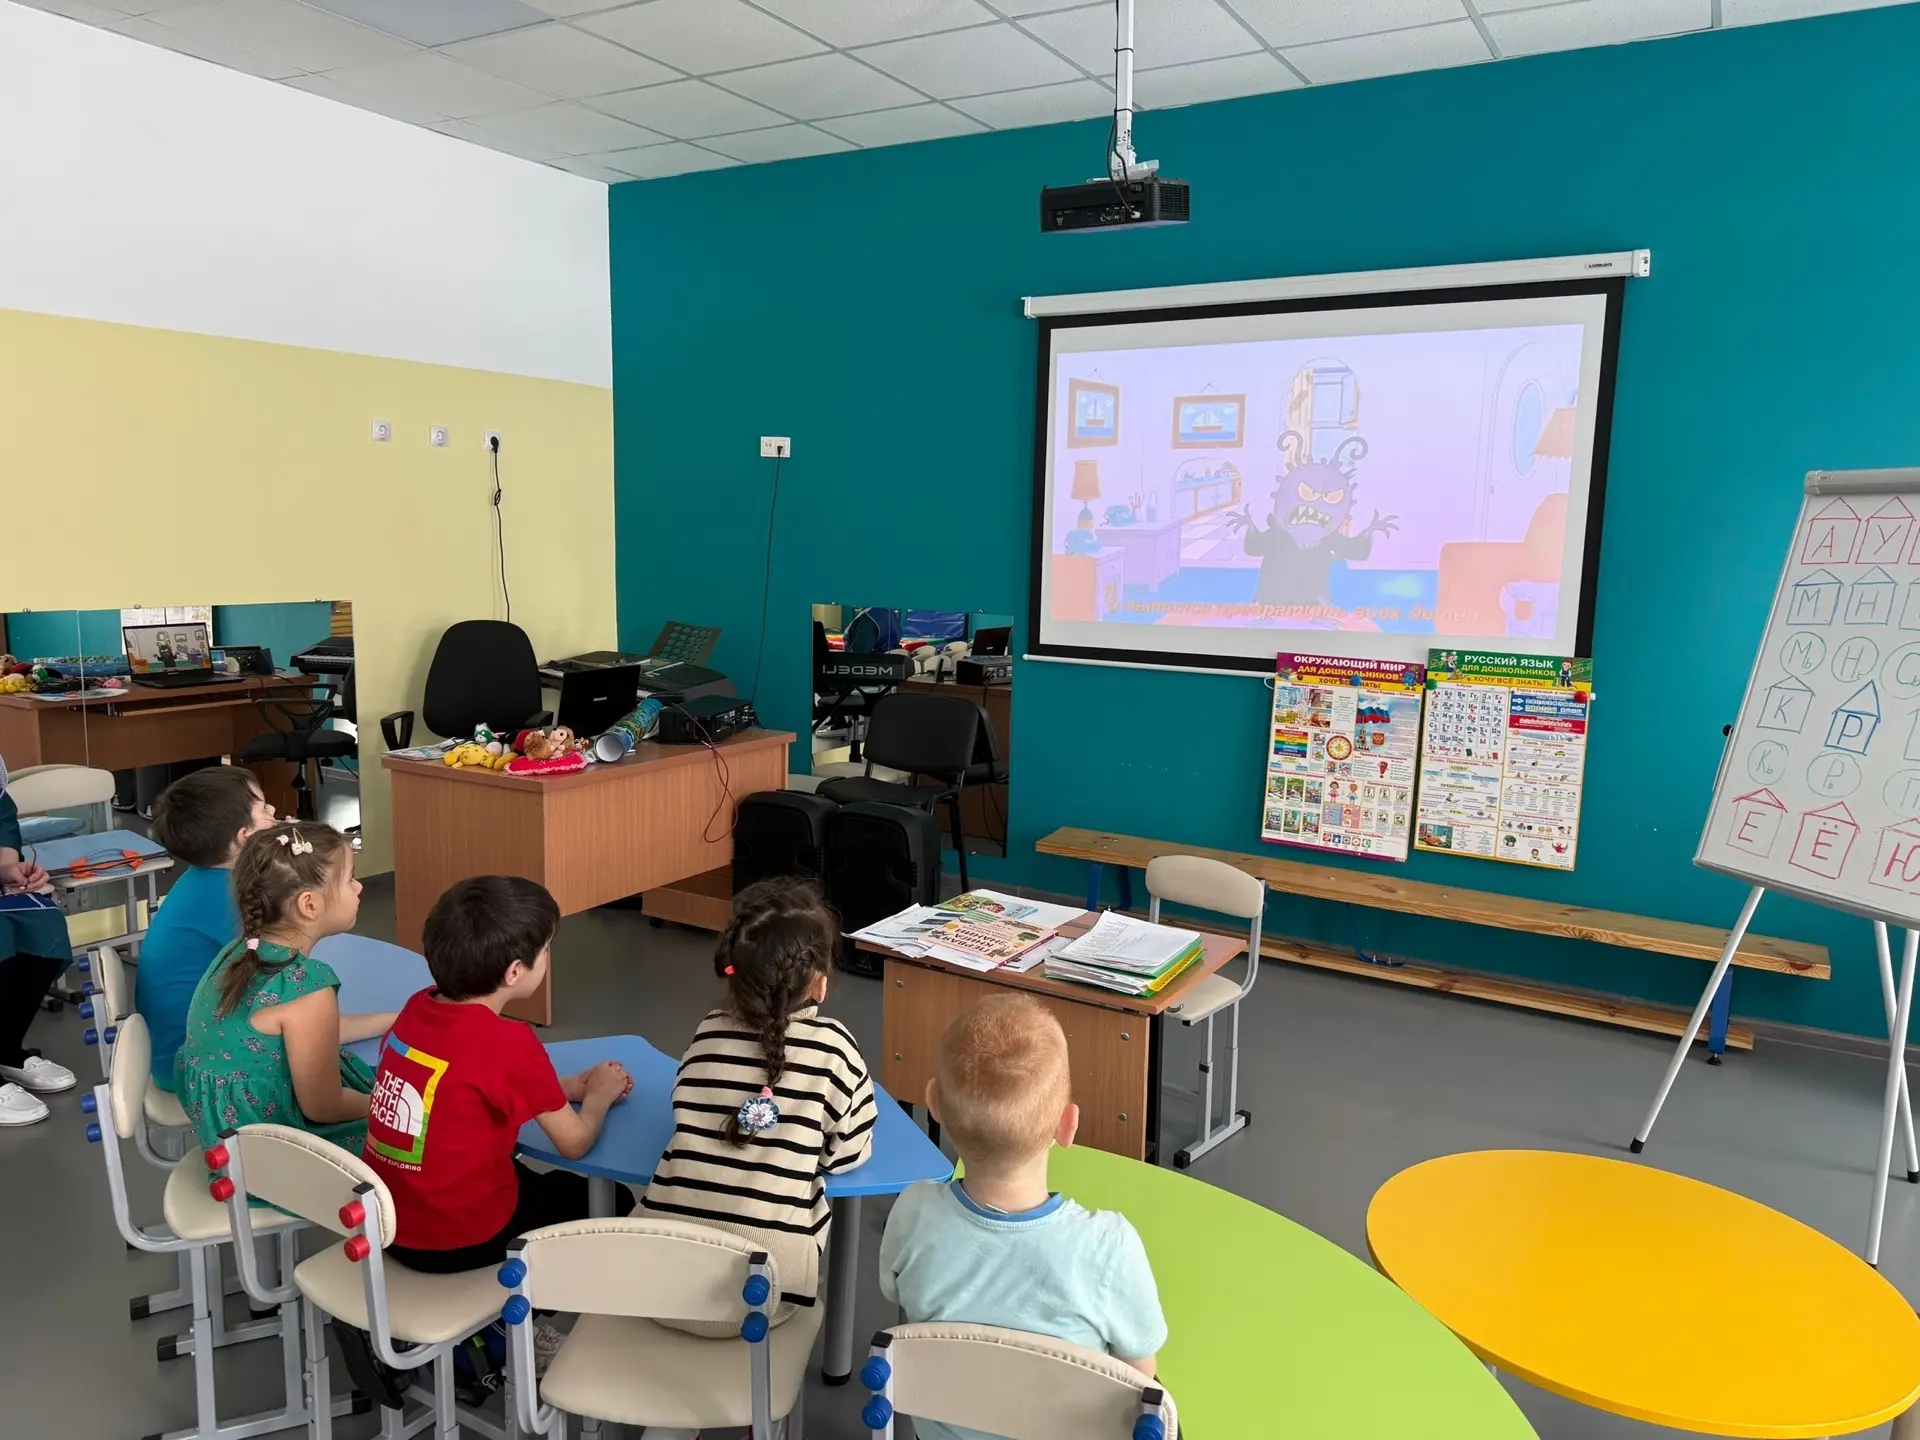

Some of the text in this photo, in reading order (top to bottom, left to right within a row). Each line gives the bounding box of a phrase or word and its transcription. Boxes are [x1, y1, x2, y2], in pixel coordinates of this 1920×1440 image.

[1811, 524, 1901, 558] А У
[1797, 588, 1879, 619] М Н
[1294, 655, 1406, 672] ОКРУЖАЮЩИЙ МИР
[1461, 664, 1556, 677] ДЛЯ ДОШКОЛЬНИКОВ
[1465, 655, 1554, 669] РУССКИЙ ЯЗЫК
[1297, 665, 1399, 680] ДЛЯ ДОШКОЛЬНИКОВ
[1515, 679, 1546, 687] ЗНАТЬ!
[1773, 694, 1863, 745] К Р
[1737, 810, 1766, 843] Е
[1811, 821, 1839, 861] Ё
[942, 936, 991, 953] ПЕРВАЯ
[955, 933, 995, 947] КНИГА
[382, 1069, 404, 1096] THE
[372, 1080, 398, 1112] ORTH
[388, 1160, 422, 1172] EXPLORING
